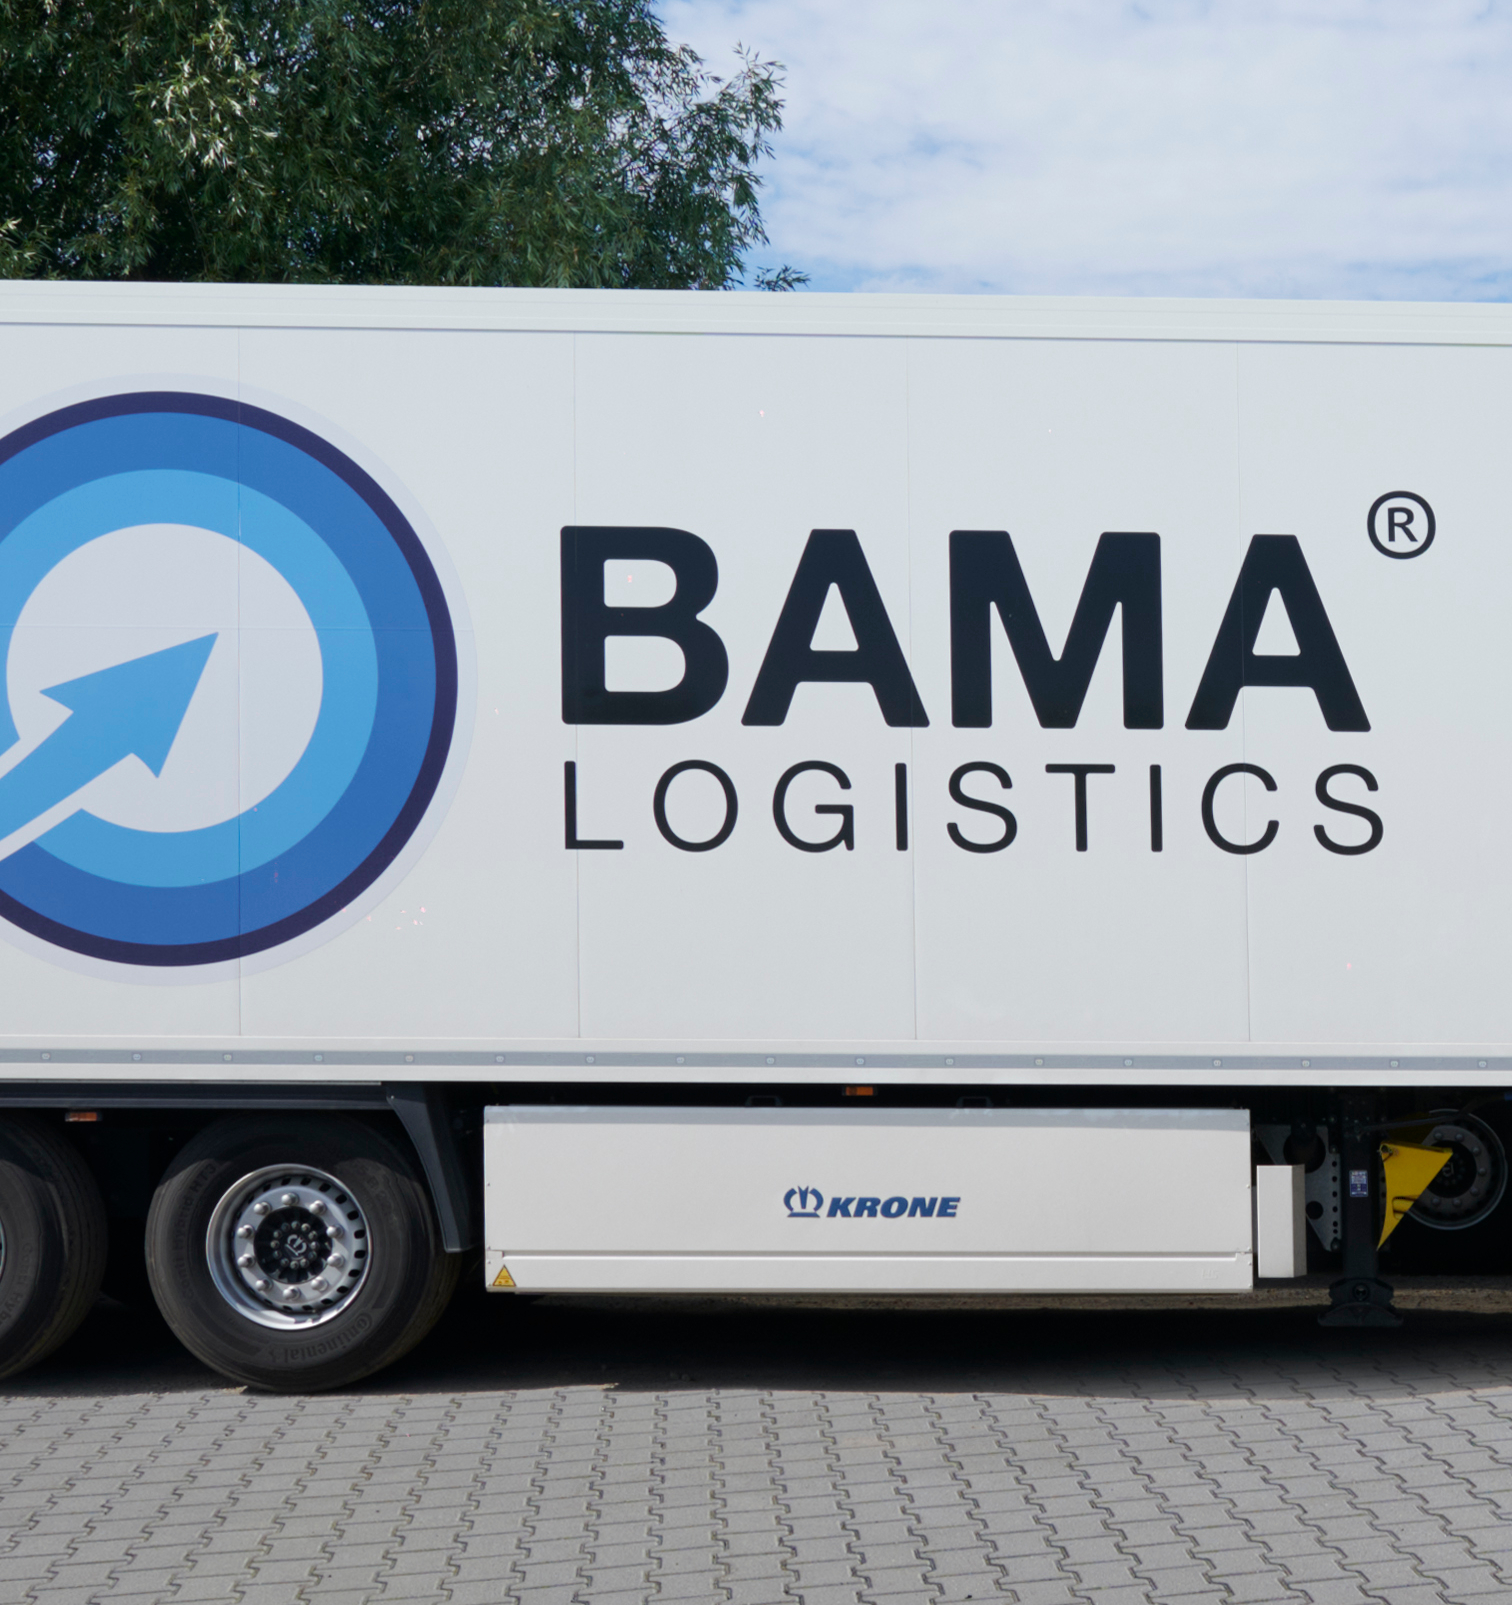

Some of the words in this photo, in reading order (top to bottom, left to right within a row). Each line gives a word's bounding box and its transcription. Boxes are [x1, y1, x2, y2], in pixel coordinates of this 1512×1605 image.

[559, 525, 1372, 733] BAMA
[563, 759, 1384, 856] LOGISTICS
[826, 1195, 962, 1219] KRONE
[283, 1311, 374, 1364] Continental
